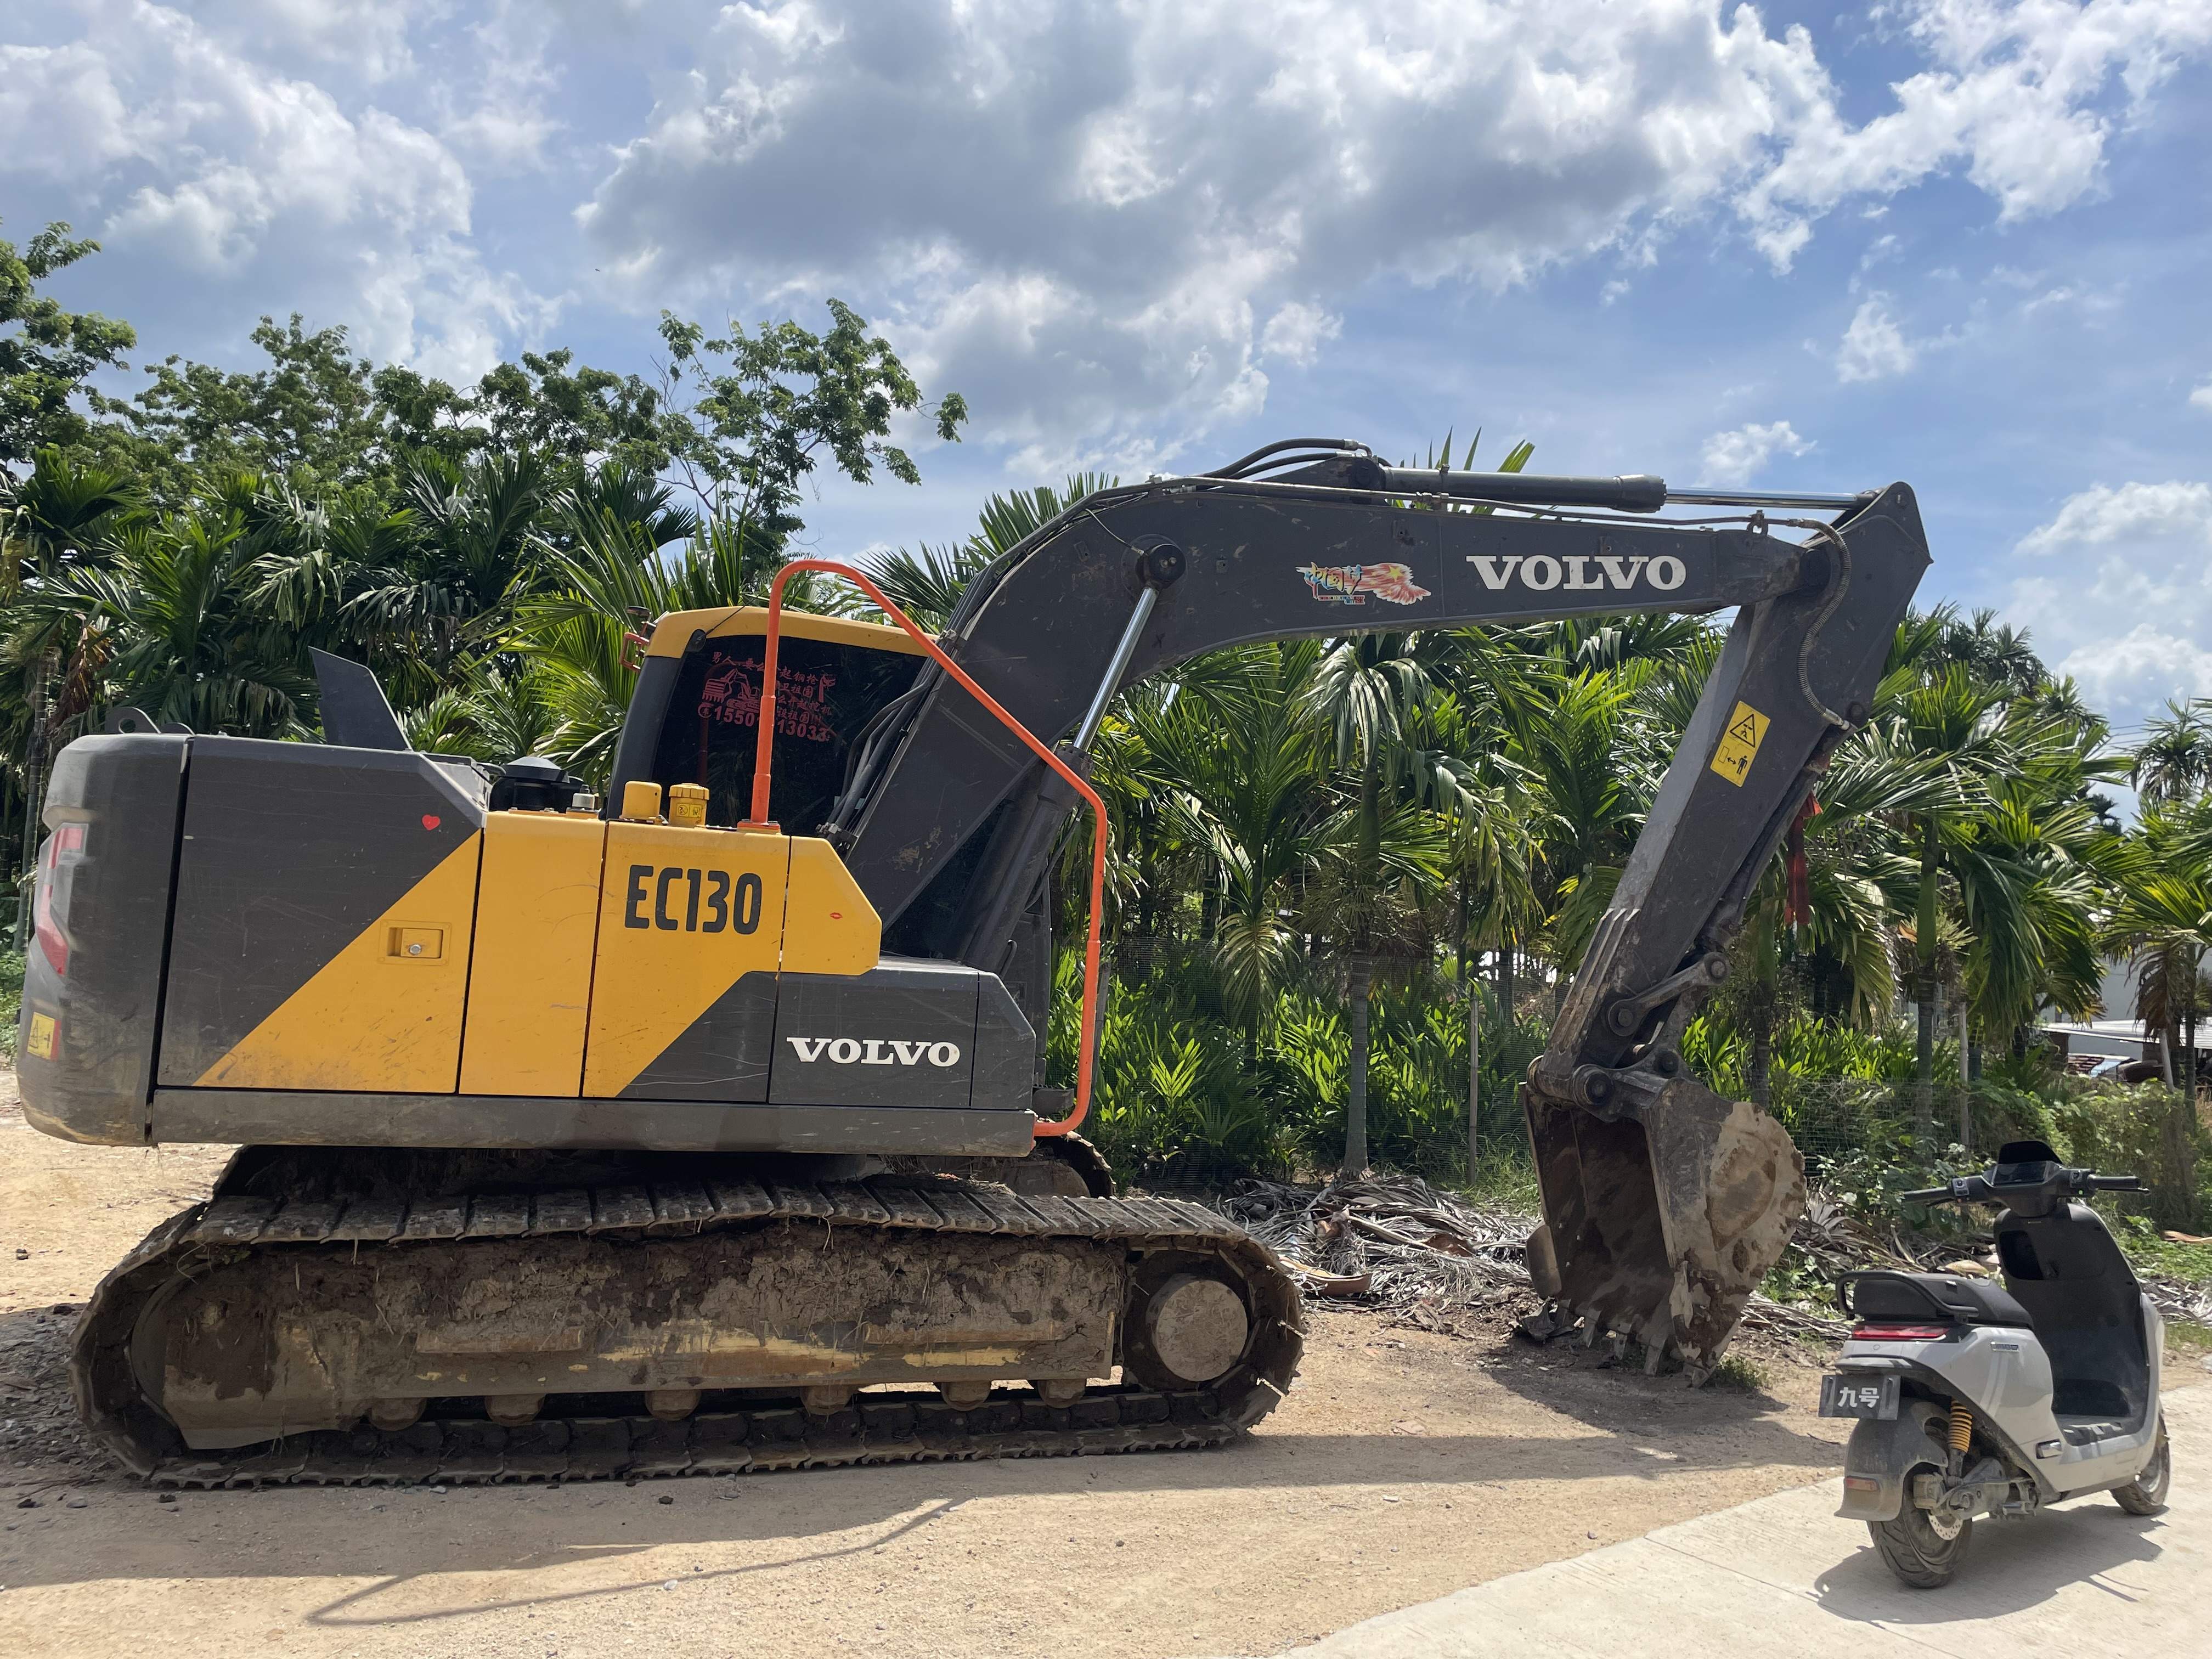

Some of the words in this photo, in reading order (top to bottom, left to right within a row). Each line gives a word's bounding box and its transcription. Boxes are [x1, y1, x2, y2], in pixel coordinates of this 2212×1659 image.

[1466, 555, 1686, 590] VOLVO
[776, 681, 812, 697] 卫祖国
[714, 706, 827, 742] 155013033
[624, 865, 762, 935] EC130
[787, 1037, 960, 1067] VOLVO
[1837, 1386, 1880, 1409] 九号
